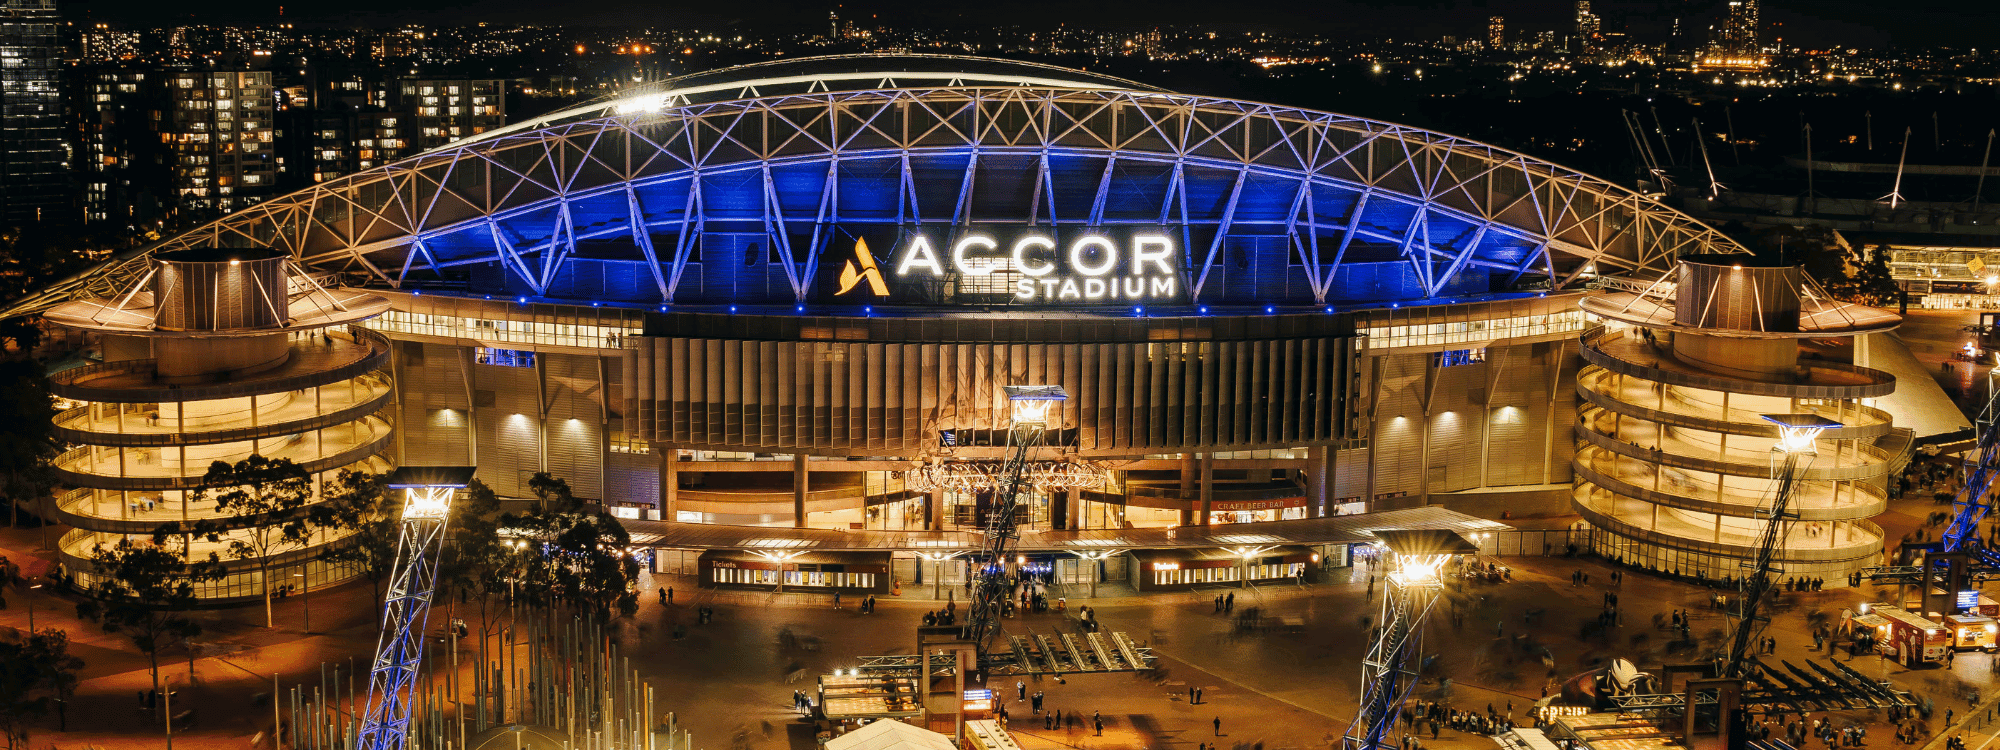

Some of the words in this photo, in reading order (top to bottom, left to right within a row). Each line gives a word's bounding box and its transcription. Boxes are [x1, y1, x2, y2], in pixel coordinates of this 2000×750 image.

[897, 236, 1174, 276] ACCOR
[1015, 277, 1174, 299] STADIUM
[1217, 502, 1245, 510] CRAFT
[1269, 500, 1284, 508] BAR
[712, 560, 737, 568] Tickets
